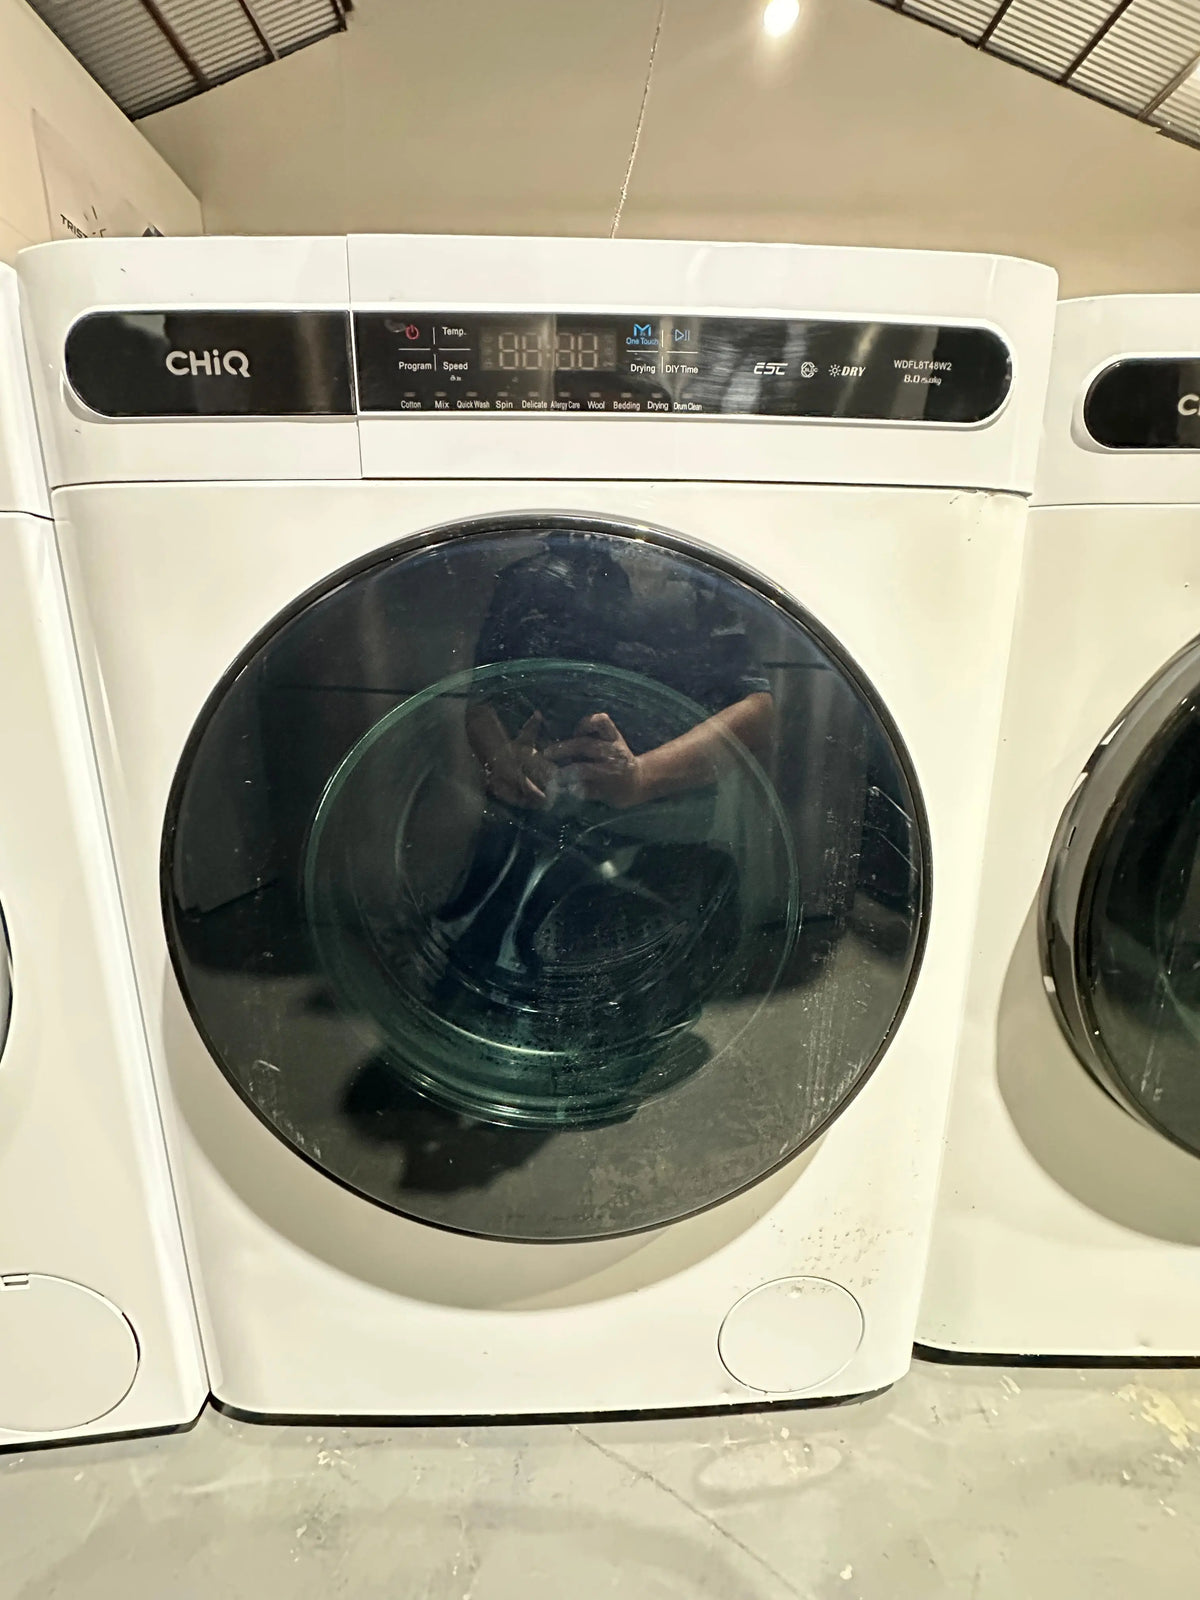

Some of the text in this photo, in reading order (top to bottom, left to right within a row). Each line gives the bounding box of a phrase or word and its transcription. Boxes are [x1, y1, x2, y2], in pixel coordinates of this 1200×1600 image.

[442, 326, 467, 337] Temp.
[625, 337, 659, 345] One Touch
[165, 349, 251, 378] CHiQ
[398, 361, 432, 372] Program
[442, 361, 469, 372] Speed
[630, 363, 656, 374] Drying
[893, 359, 953, 371] WDFL8T48W2
[665, 364, 699, 374] DIY Time
[841, 365, 866, 377] DRY
[400, 400, 421, 409] Cotton
[434, 400, 450, 409] Mix
[456, 400, 490, 409] Quick Wash
[495, 400, 513, 410] Spin
[521, 400, 548, 409] Delicate
[550, 401, 581, 411] Allergy Care
[587, 401, 606, 410] Wool
[613, 401, 641, 411] Bedding
[647, 401, 669, 411] Drying
[673, 402, 703, 411] Drum Clean
[1177, 393, 1200, 416] C
